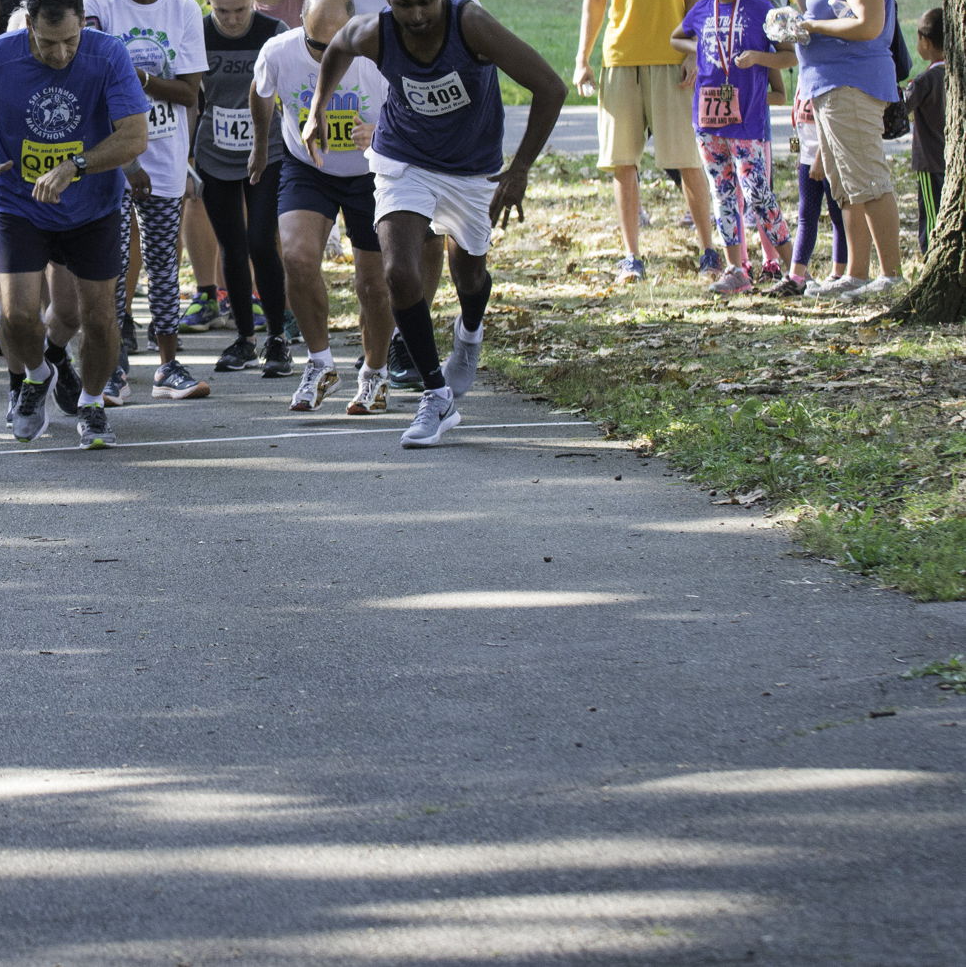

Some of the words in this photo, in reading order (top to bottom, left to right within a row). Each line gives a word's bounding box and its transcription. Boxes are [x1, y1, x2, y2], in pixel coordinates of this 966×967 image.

[223, 59, 255, 74] asic
[29, 92, 41, 105] SRI
[42, 86, 78, 103] CHINMOY
[704, 97, 732, 117] 773
[25, 117, 65, 140] MARATHON
[66, 114, 82, 133] TEAM
[215, 118, 253, 140] H42
